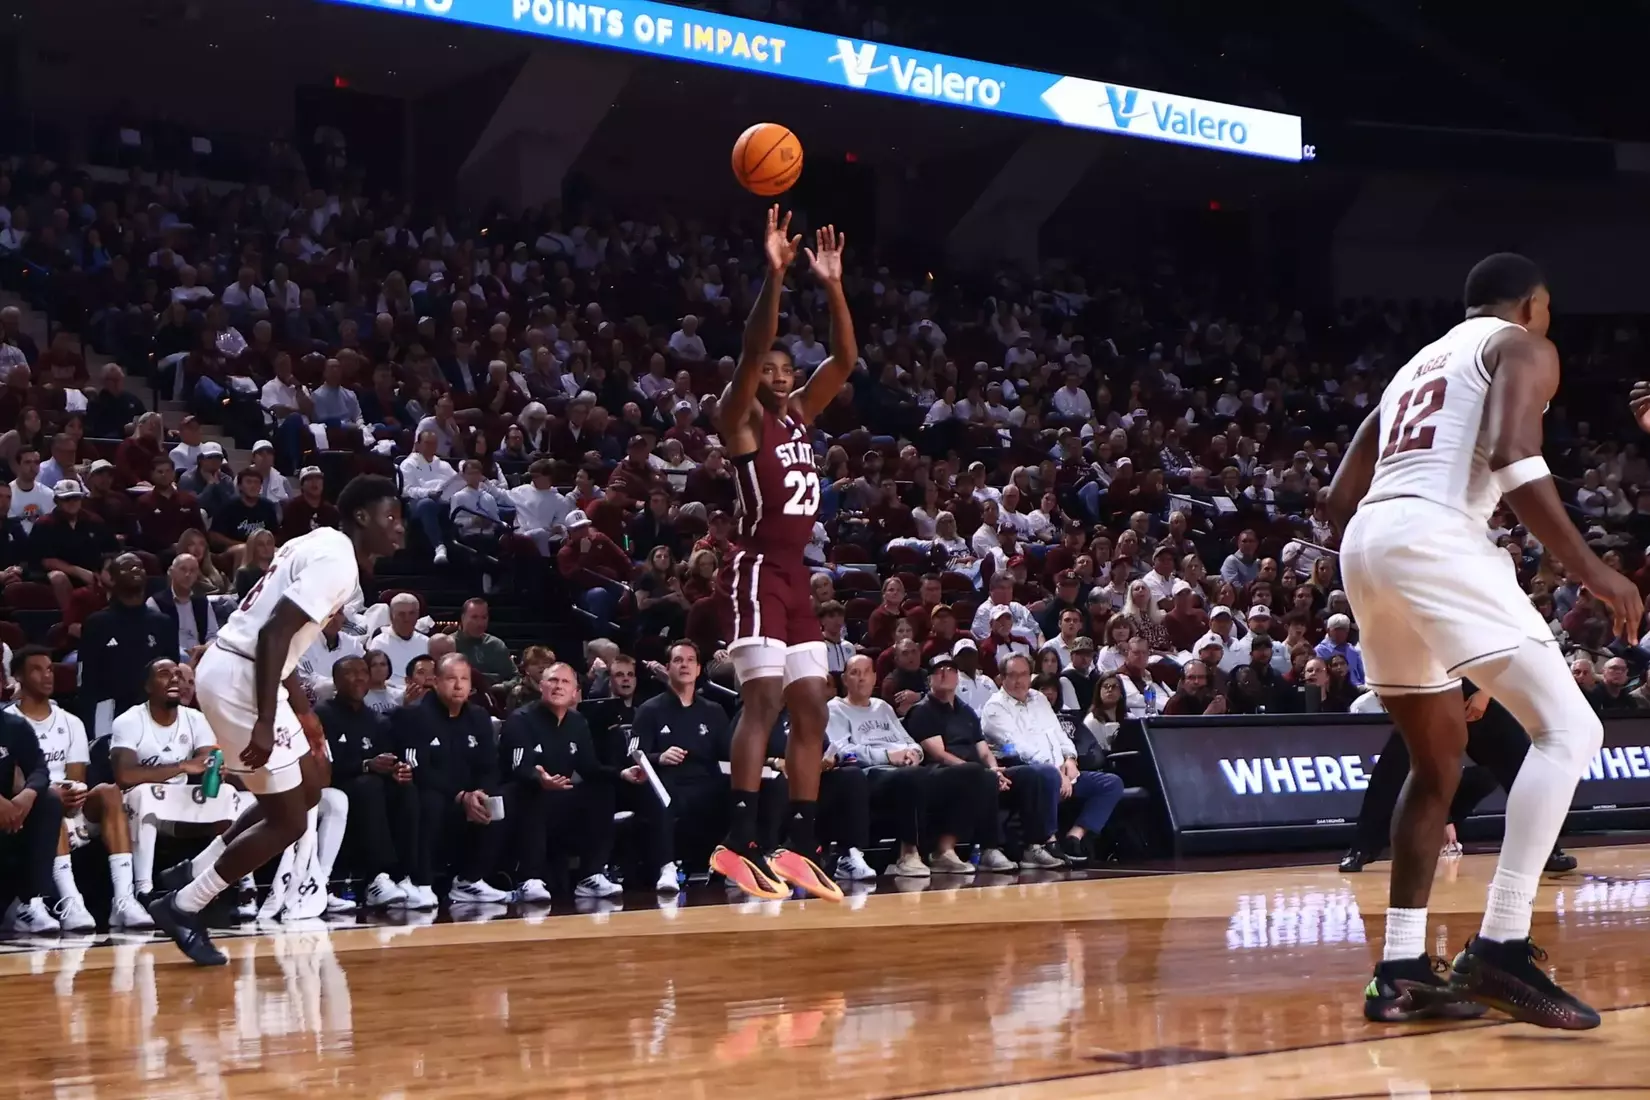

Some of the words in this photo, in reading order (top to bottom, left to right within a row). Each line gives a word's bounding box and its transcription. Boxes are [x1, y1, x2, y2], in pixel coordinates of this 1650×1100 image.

[512, 0, 624, 38] POINTS
[633, 14, 673, 45] OF
[683, 22, 786, 64] IMPACT
[889, 54, 1003, 106] Valero
[1151, 100, 1248, 145] Valero
[1412, 352, 1453, 381] AGEE
[1381, 376, 1448, 461] 12
[783, 470, 820, 516] 23
[1218, 754, 1371, 796] WHERE
